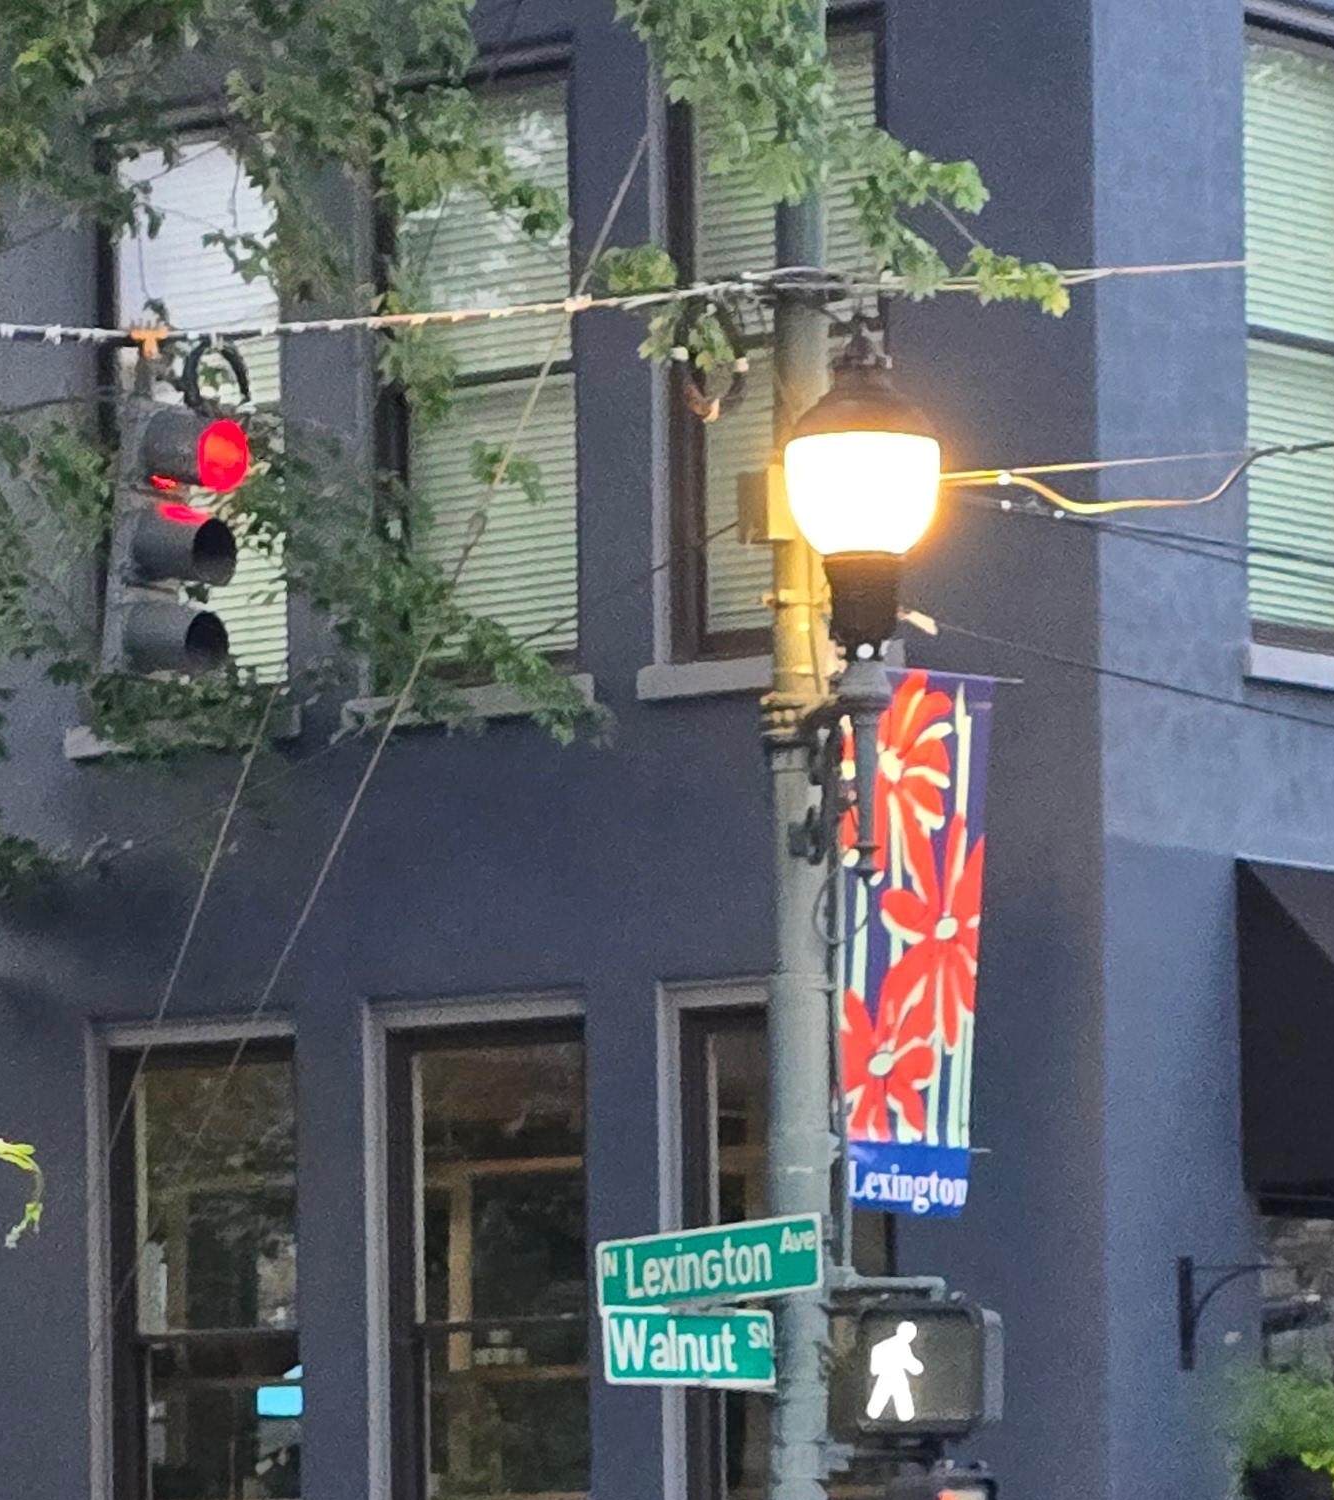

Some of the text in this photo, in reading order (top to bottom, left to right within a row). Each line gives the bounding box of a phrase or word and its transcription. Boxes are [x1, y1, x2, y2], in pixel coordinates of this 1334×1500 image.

[848, 1160, 968, 1214] Lexington
[603, 1250, 618, 1276] N
[780, 1226, 817, 1254] Ave
[609, 1318, 770, 1373] Walnut St
